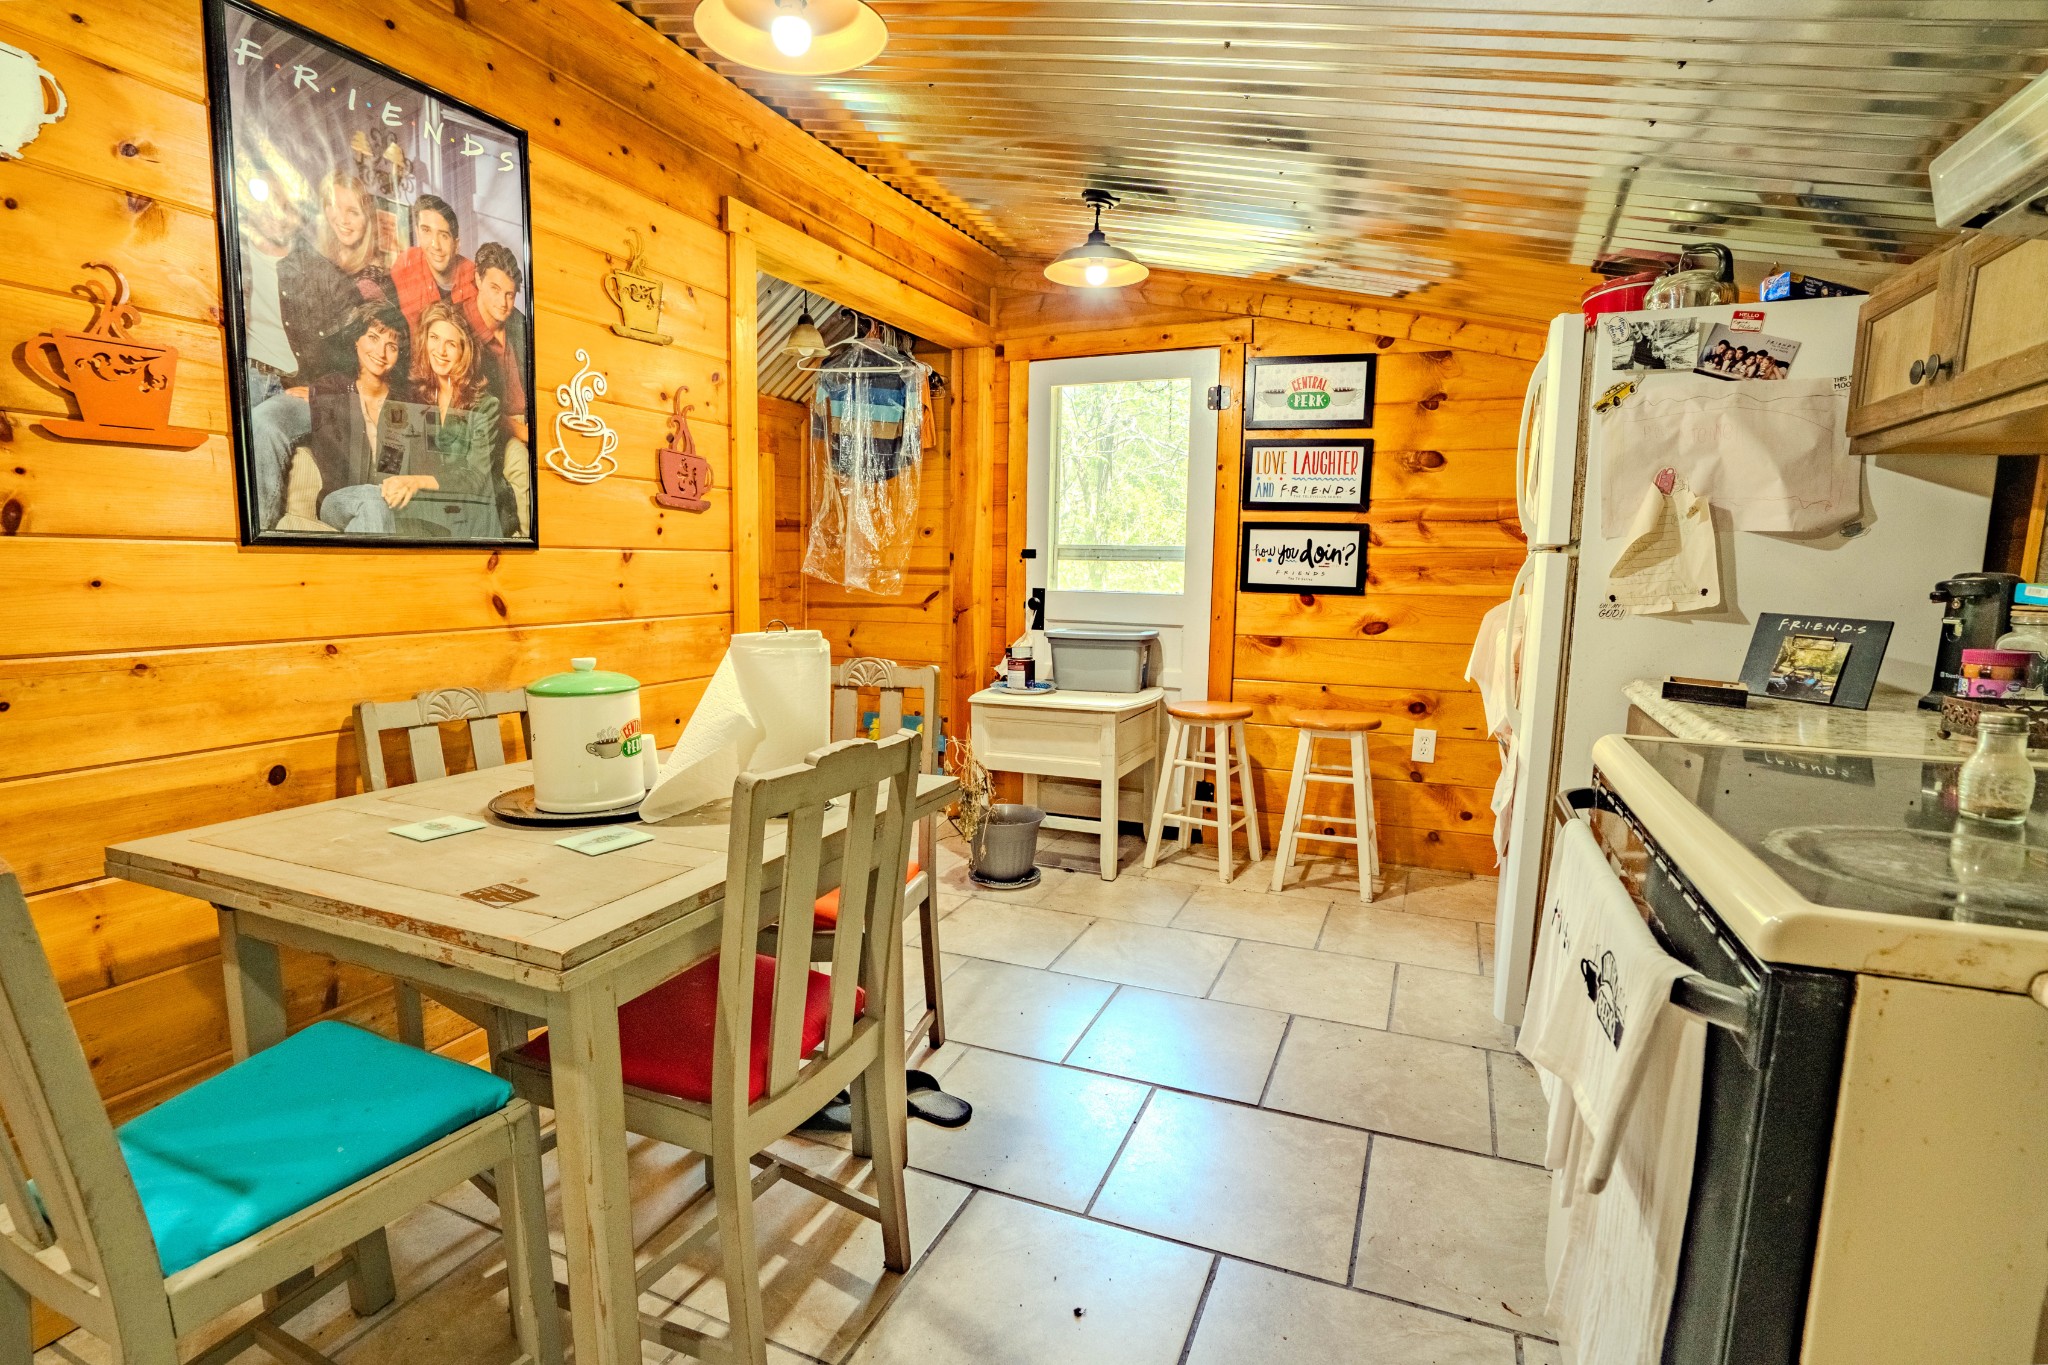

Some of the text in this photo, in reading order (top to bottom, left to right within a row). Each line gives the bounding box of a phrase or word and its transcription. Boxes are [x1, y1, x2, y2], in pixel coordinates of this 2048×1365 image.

[1291, 375, 1328, 392] CENTRAL
[1833, 375, 1848, 383] THIS
[1293, 393, 1326, 408] PERK
[1256, 450, 1359, 475] LOVE LAUGHTER
[1255, 482, 1275, 498] AND
[1252, 543, 1276, 557] how
[1278, 544, 1299, 565] you
